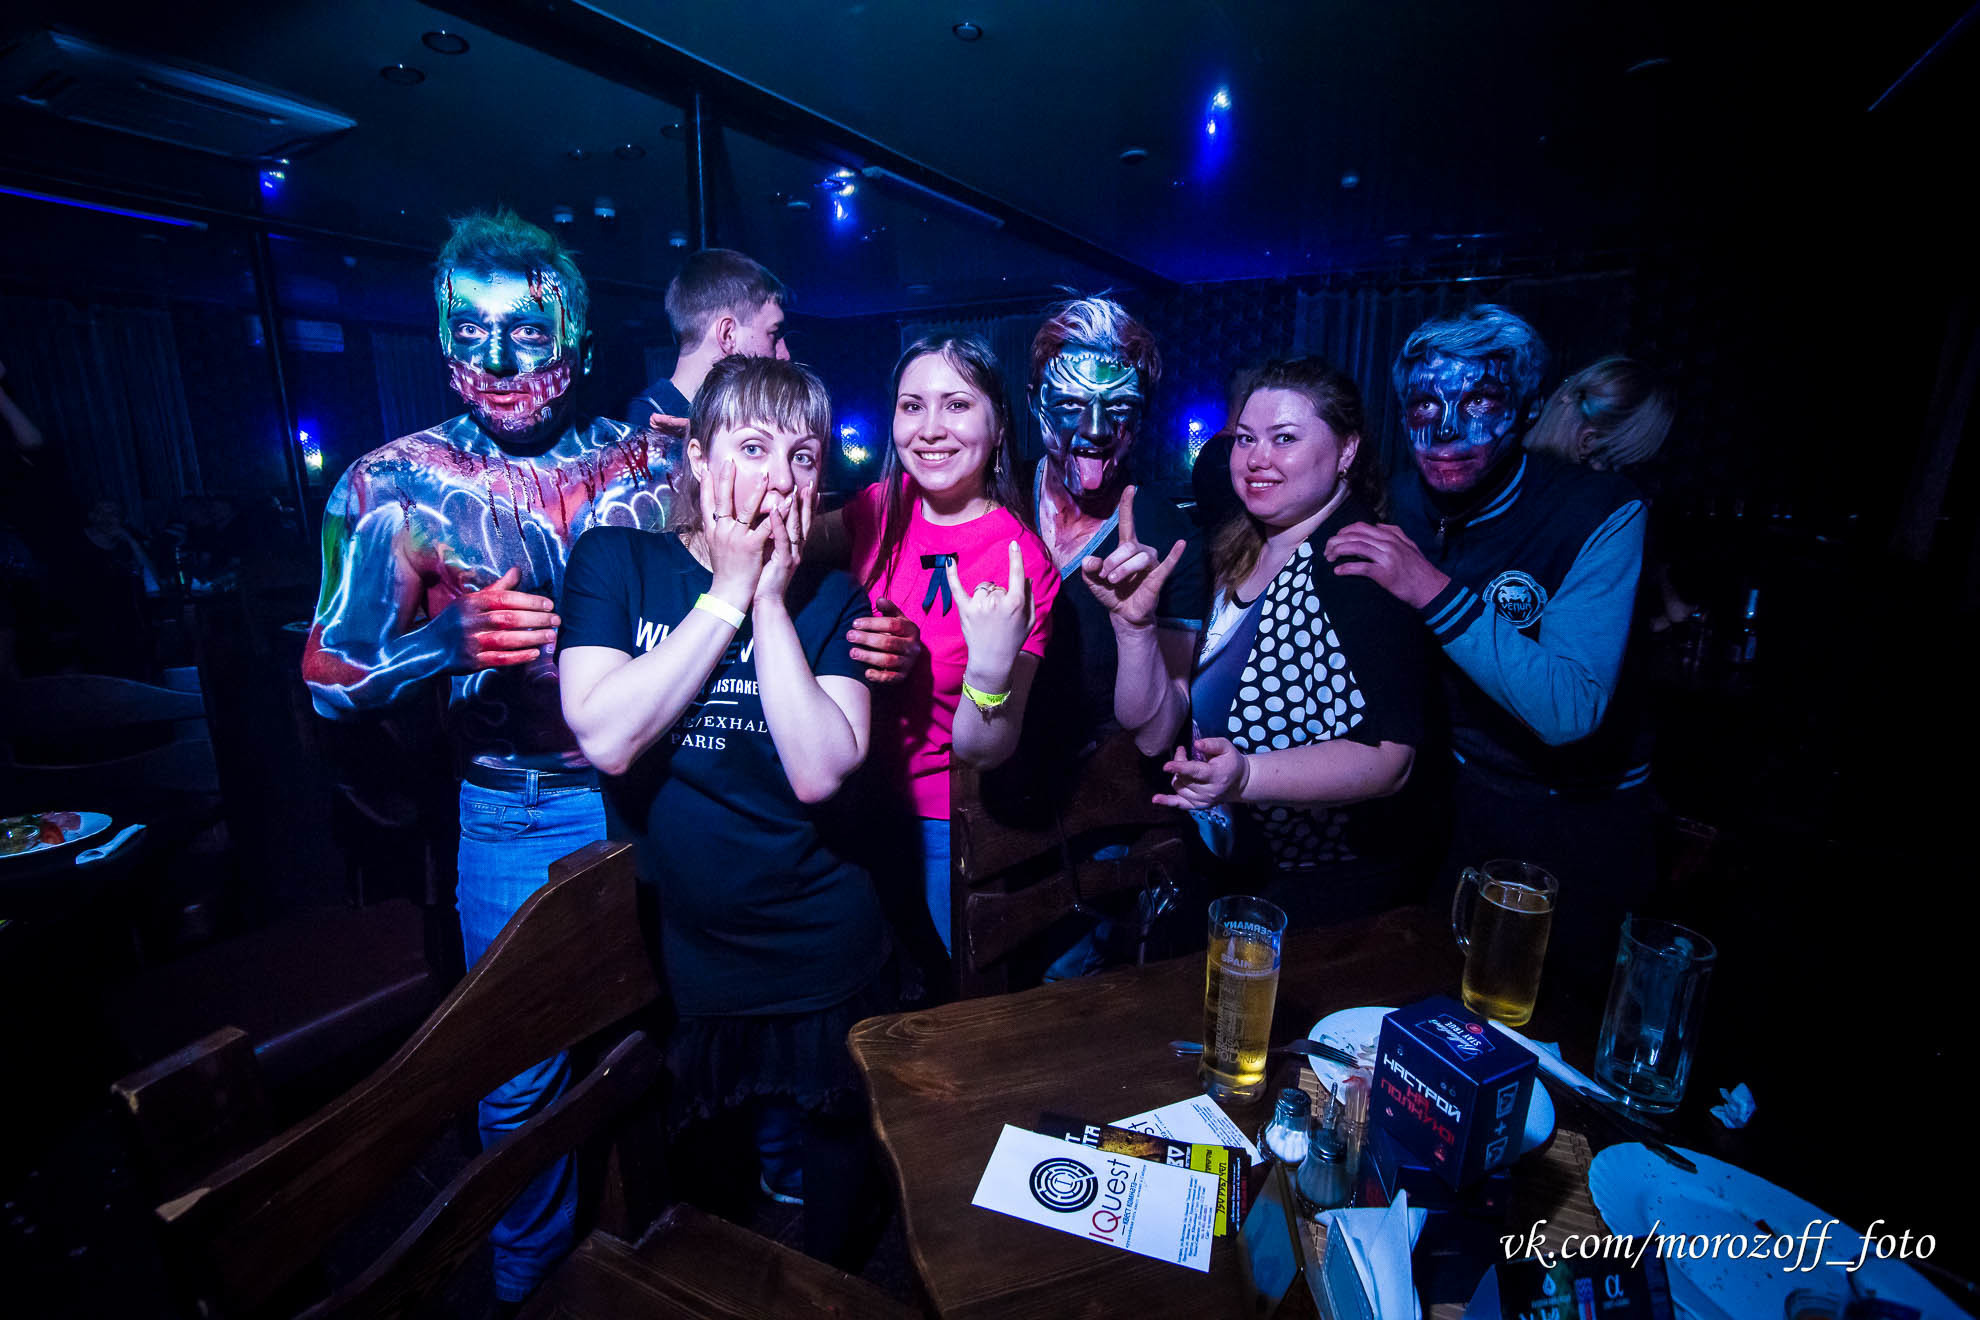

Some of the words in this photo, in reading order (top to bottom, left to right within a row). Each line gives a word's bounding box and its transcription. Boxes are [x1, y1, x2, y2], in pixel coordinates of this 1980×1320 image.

[671, 732, 726, 750] PARIS
[1445, 1021, 1462, 1036] TRUE
[1463, 1032, 1482, 1047] STAY
[1383, 1053, 1462, 1123] НАСТРОЙ
[1089, 1158, 1132, 1242] IQuest
